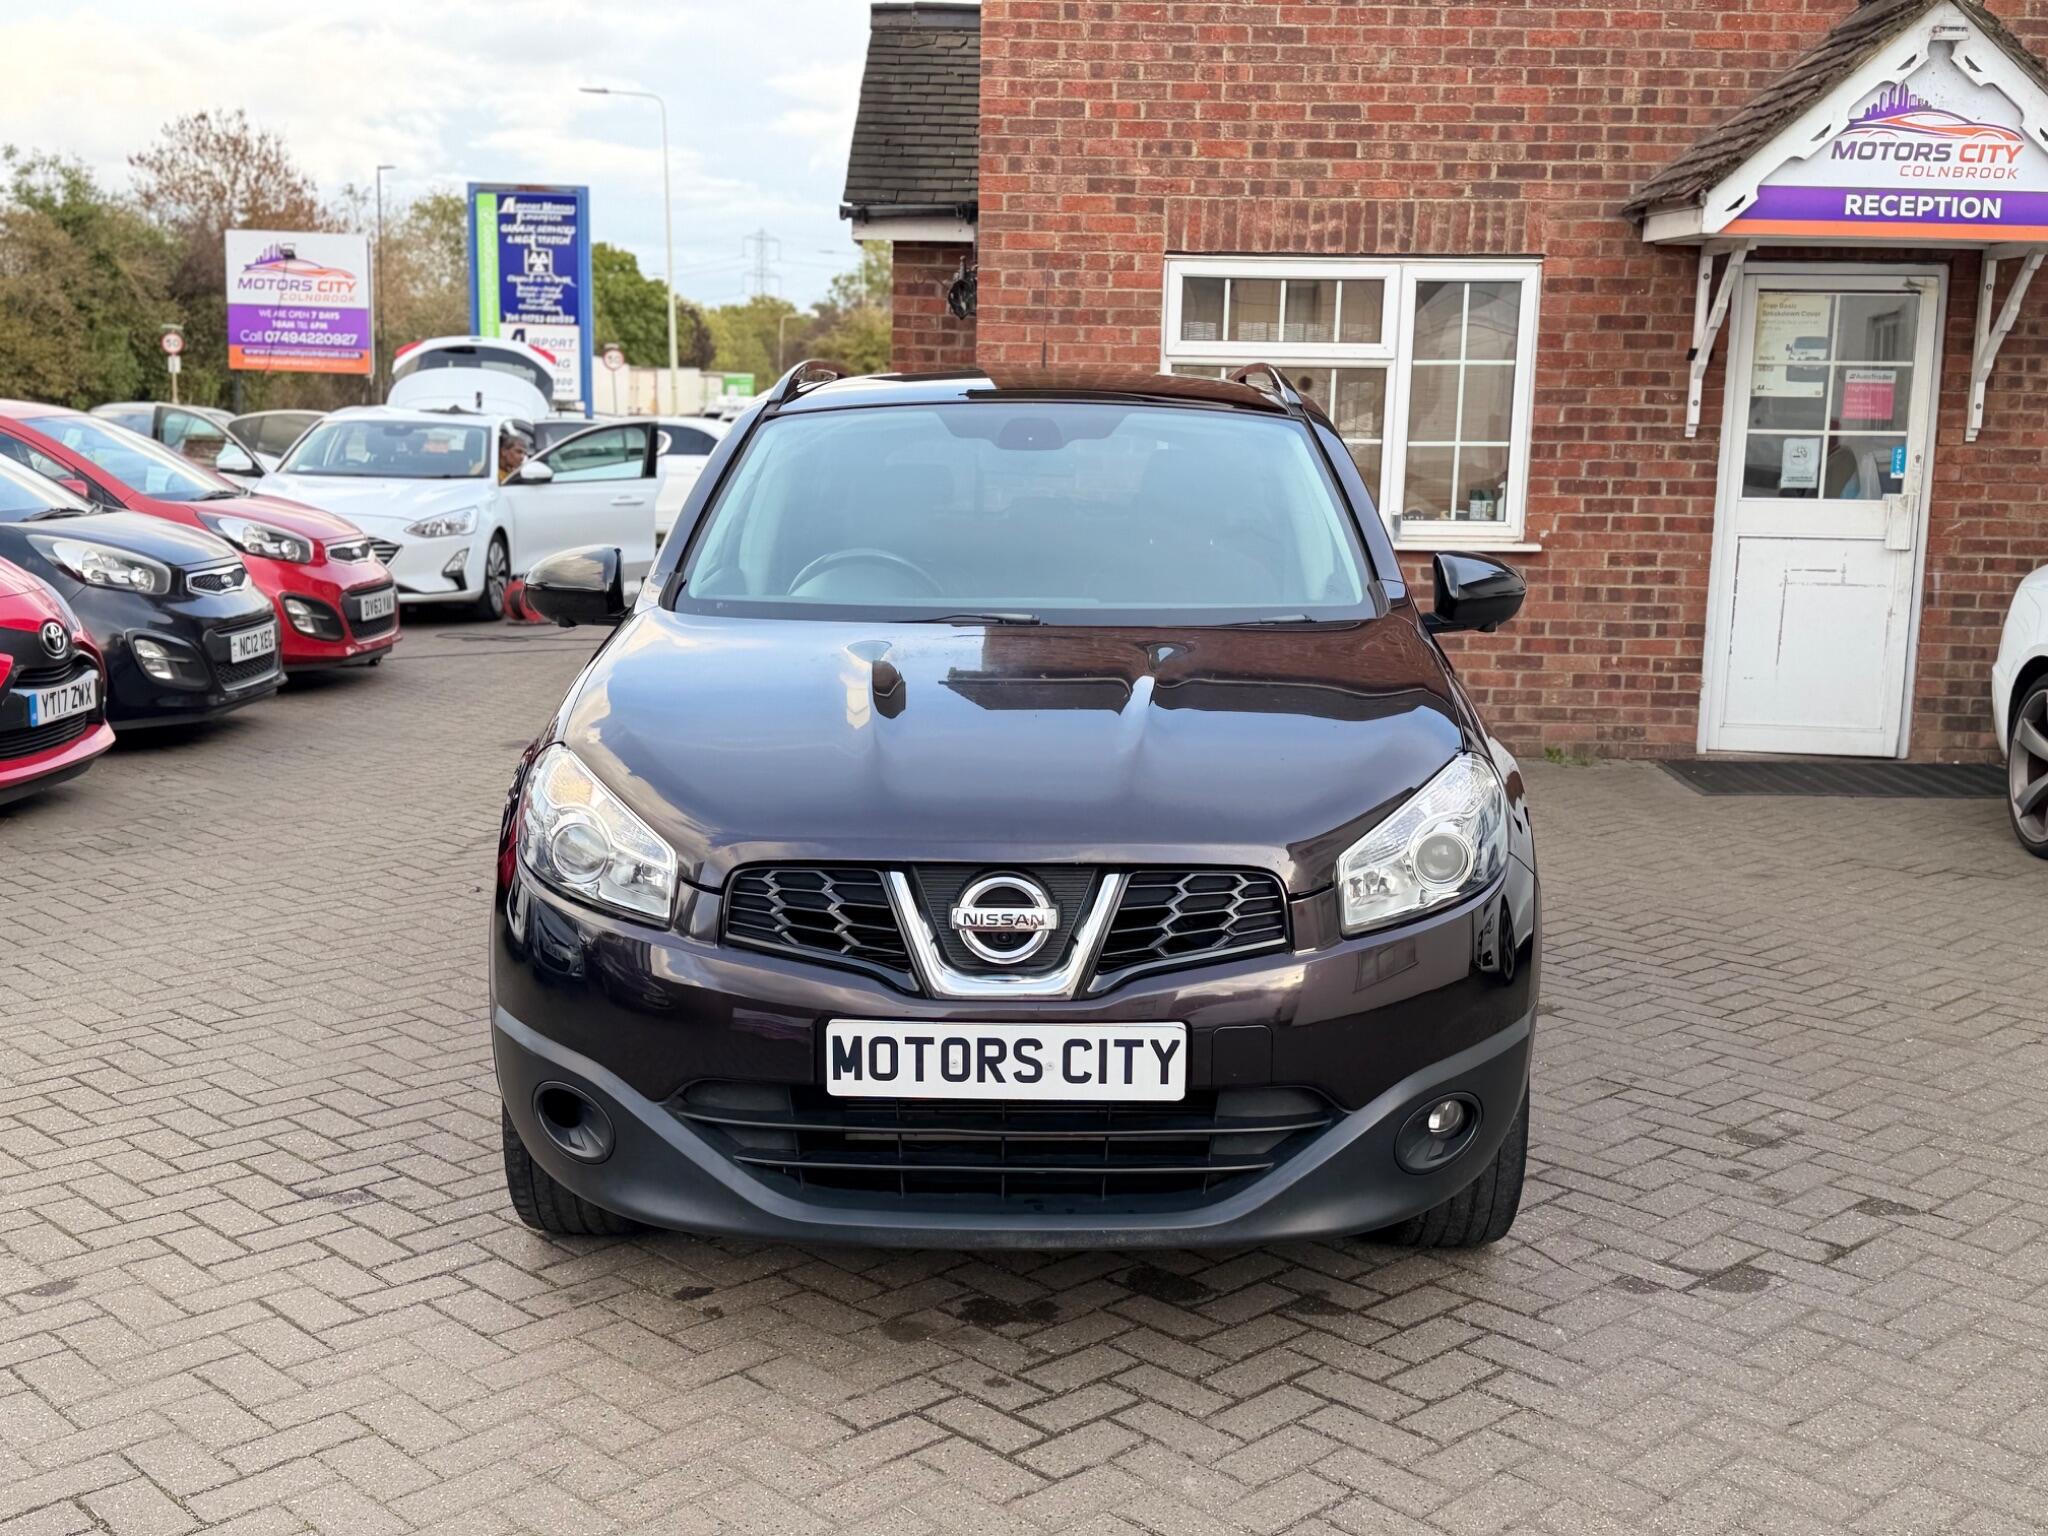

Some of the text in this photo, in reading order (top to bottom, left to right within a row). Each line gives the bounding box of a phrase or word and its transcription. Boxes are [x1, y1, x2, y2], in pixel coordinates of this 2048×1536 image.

[1831, 141, 2025, 164] MOTORS CITY
[1900, 164, 2019, 180] COLNBROOK
[1844, 194, 2002, 219] RECEPTION
[238, 278, 356, 293] MOTORS CITY
[280, 292, 355, 303] COLNBROOK
[258, 309, 340, 320] WE ARE OPEN 7 DAYS
[166, 338, 179, 348] 50
[240, 329, 358, 346] Call 07494220927
[511, 327, 576, 348] AIRPORT
[240, 629, 273, 656] NC12 XEG
[41, 681, 92, 718] YT17 ZWX
[963, 913, 1045, 926] NISSAN
[832, 1035, 1181, 1085] MOTORS CITY
